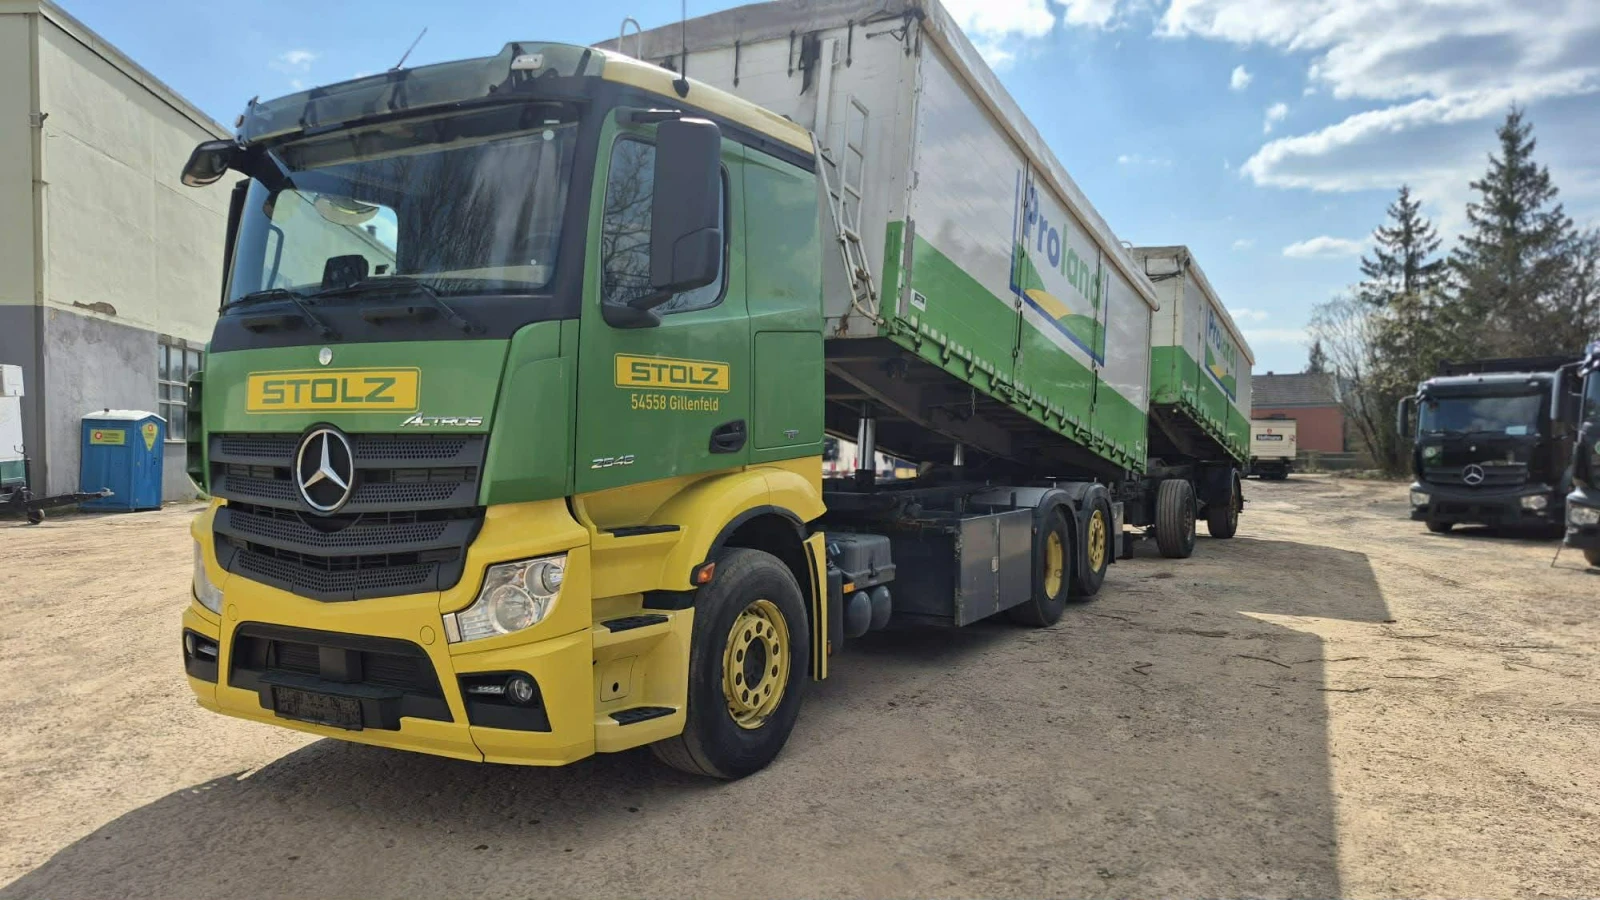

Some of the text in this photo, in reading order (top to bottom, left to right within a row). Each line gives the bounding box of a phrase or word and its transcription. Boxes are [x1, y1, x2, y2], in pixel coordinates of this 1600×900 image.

[1024, 179, 1106, 313] Proland
[631, 361, 719, 385] STOLZ
[262, 377, 396, 404] STOLZ
[631, 393, 719, 412] 54558 Gillenfeld
